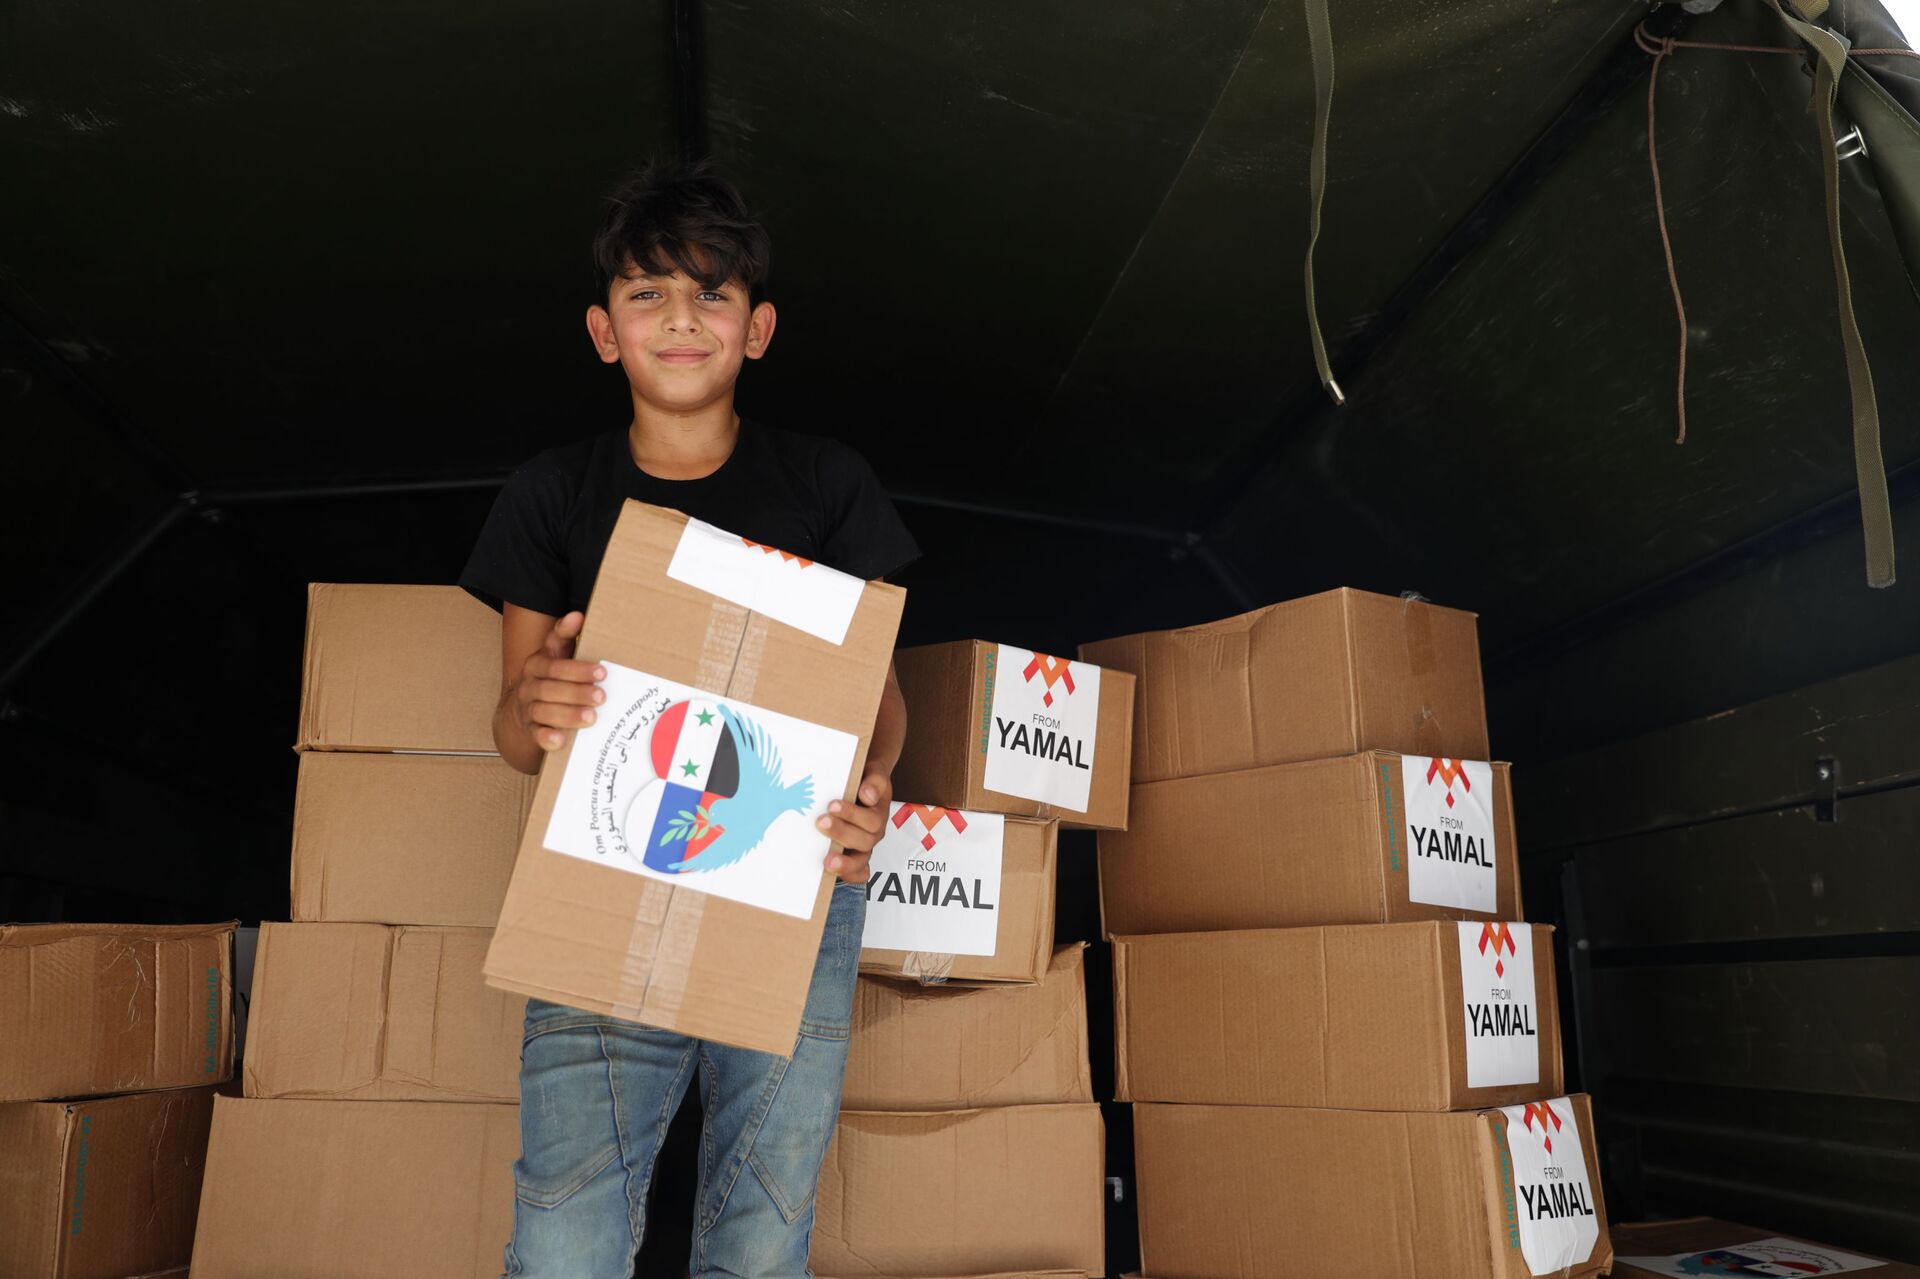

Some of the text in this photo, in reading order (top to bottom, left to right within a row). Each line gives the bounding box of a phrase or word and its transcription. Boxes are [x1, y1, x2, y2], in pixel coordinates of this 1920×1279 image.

[655, 697, 671, 714] من
[1033, 713, 1061, 731] FROM
[996, 716, 1089, 770] YAMAL
[590, 686, 659, 855] От России сирийскому народу
[1440, 816, 1463, 830] FROM
[1410, 824, 1493, 868] YAMAL
[907, 859, 946, 876] FROM
[1491, 988, 1511, 1001] FROM
[1467, 1003, 1536, 1037] YAMAL
[1543, 1166, 1564, 1180] FROM
[1519, 1181, 1594, 1221] YAMAL
